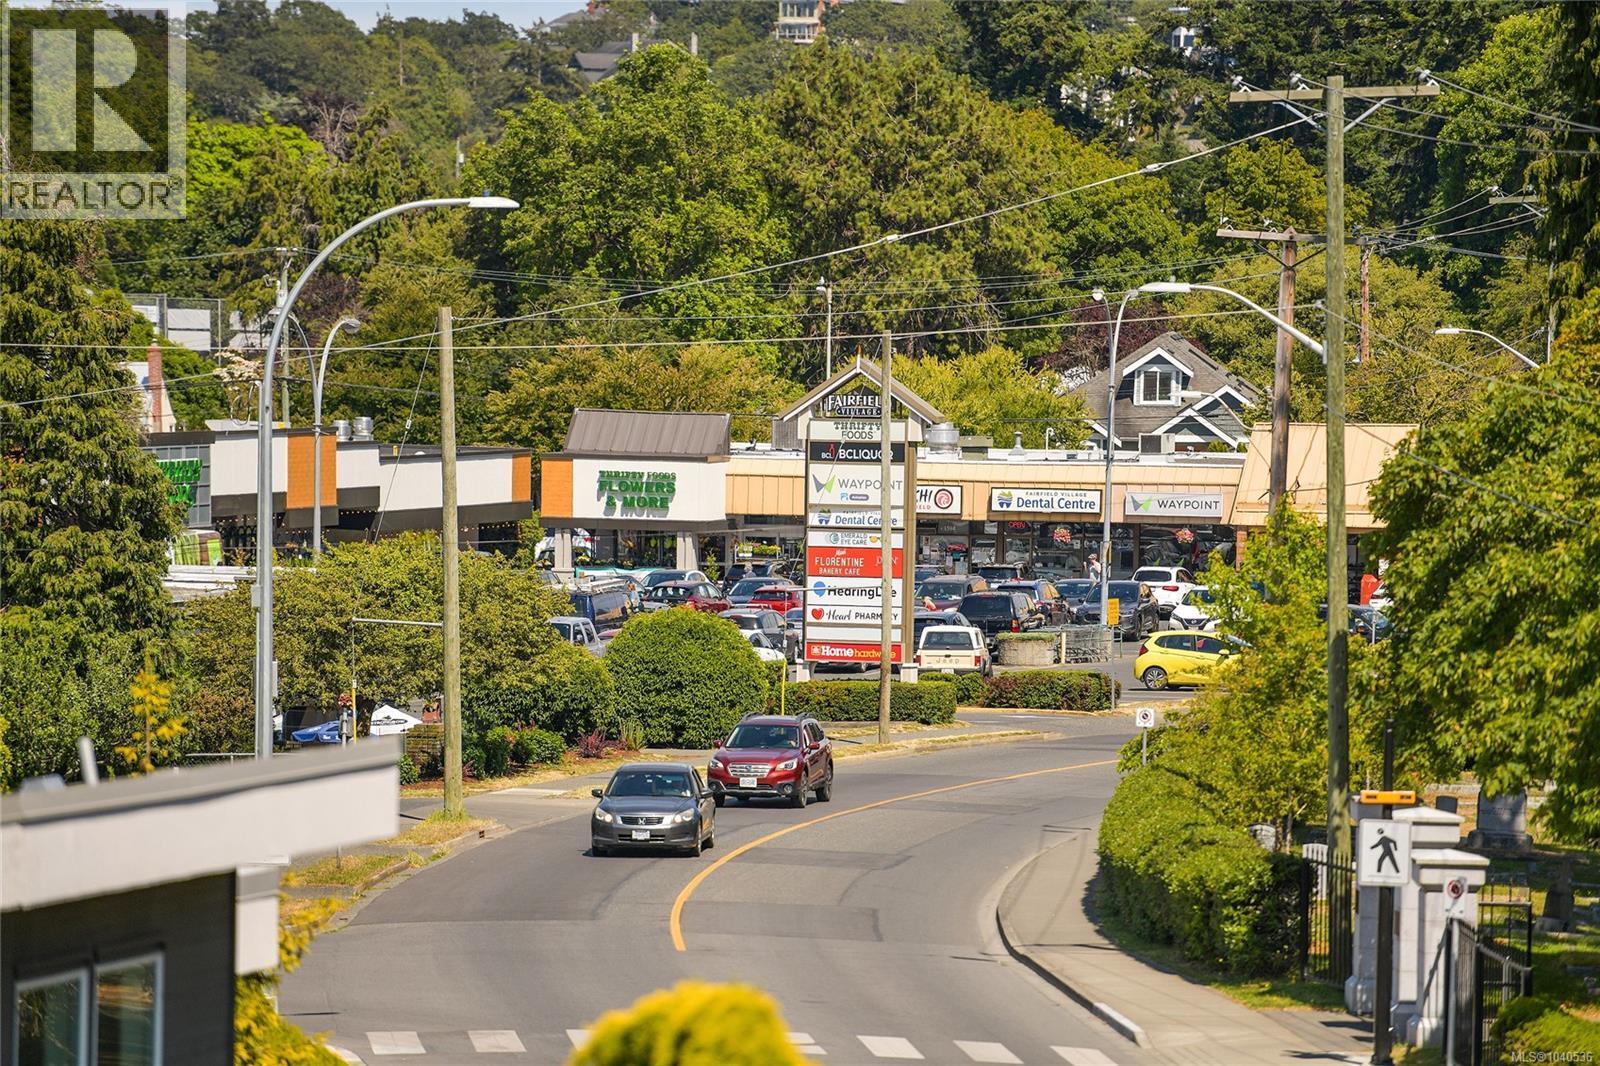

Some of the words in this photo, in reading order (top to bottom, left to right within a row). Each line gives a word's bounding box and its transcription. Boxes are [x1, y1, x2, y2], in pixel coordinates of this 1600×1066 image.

[828, 395, 882, 411] FAIRFIEL
[841, 408, 878, 416] VILLAGE
[841, 430, 874, 440] FOODS
[647, 472, 677, 480] FOODS
[598, 480, 677, 493] FLOWERS
[837, 478, 903, 491] WAYPONT
[606, 495, 617, 507] &
[622, 496, 670, 508] MORE
[1016, 497, 1055, 509] Dental
[1057, 497, 1097, 510] Centre
[1157, 499, 1221, 511] WAYPOINT
[834, 515, 865, 525] Dental
[815, 556, 865, 568] FLORENTINE
[818, 567, 842, 576] BAKERY
[844, 567, 861, 576] CAFE
[827, 585, 898, 600] HearingLe
[826, 609, 852, 621] Heart
[854, 611, 899, 621] PHARMY
[821, 645, 855, 658] Home
[854, 648, 897, 659] hardwe
